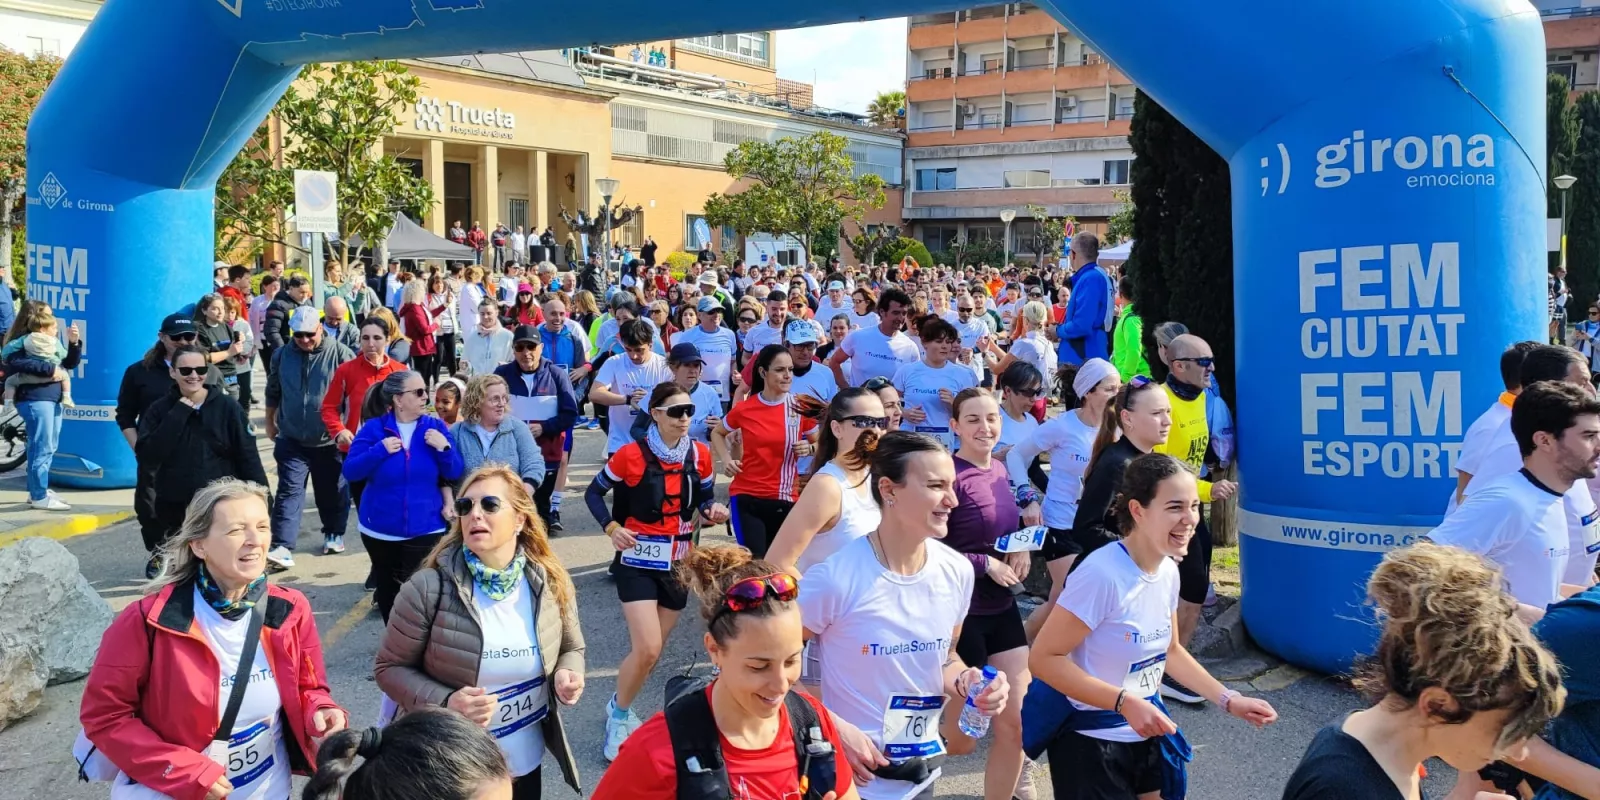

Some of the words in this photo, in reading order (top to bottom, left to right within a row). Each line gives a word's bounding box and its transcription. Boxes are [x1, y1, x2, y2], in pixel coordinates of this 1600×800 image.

[447, 101, 515, 129] Trueta
[1314, 129, 1494, 188] girona
[1406, 171, 1495, 187] emociona
[62, 198, 73, 208] de
[77, 199, 114, 212] Girona
[27, 242, 88, 285] FEM
[1299, 242, 1460, 313] FEM
[1301, 314, 1465, 359] CIUTAT
[1300, 371, 1462, 436] FEM
[1303, 441, 1464, 478] ESPORT
[633, 543, 661, 558] 943
[500, 694, 533, 723] 214
[904, 715, 929, 738] 761
[228, 743, 259, 772] 55
